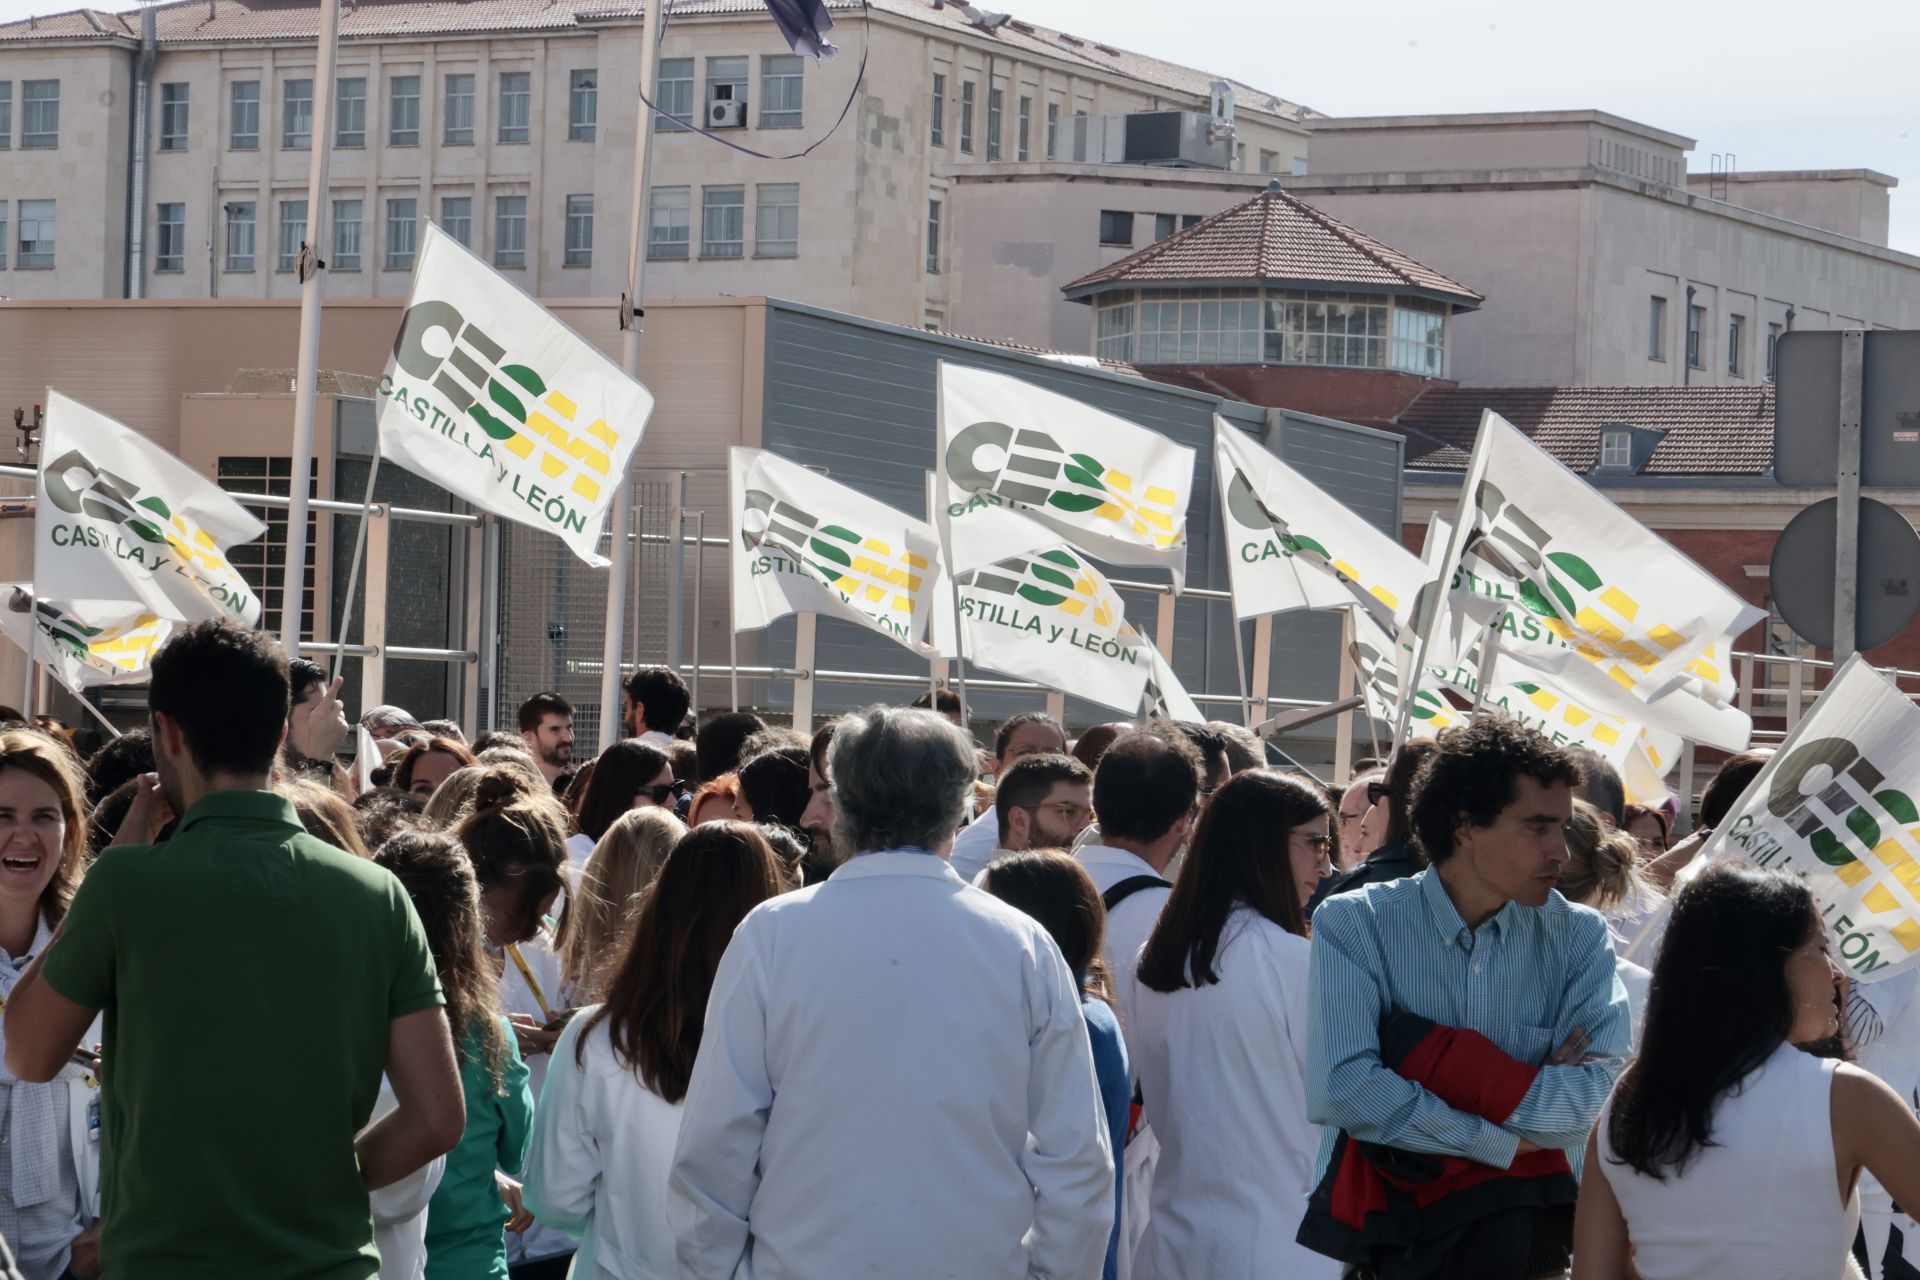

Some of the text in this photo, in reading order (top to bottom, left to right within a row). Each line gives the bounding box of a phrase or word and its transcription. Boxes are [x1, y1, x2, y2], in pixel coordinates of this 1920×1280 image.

[377, 374, 587, 533] CASTILLA y LEÓN
[149, 556, 170, 571] y
[1047, 625, 1064, 643] y
[1070, 628, 1138, 665] LEÓN
